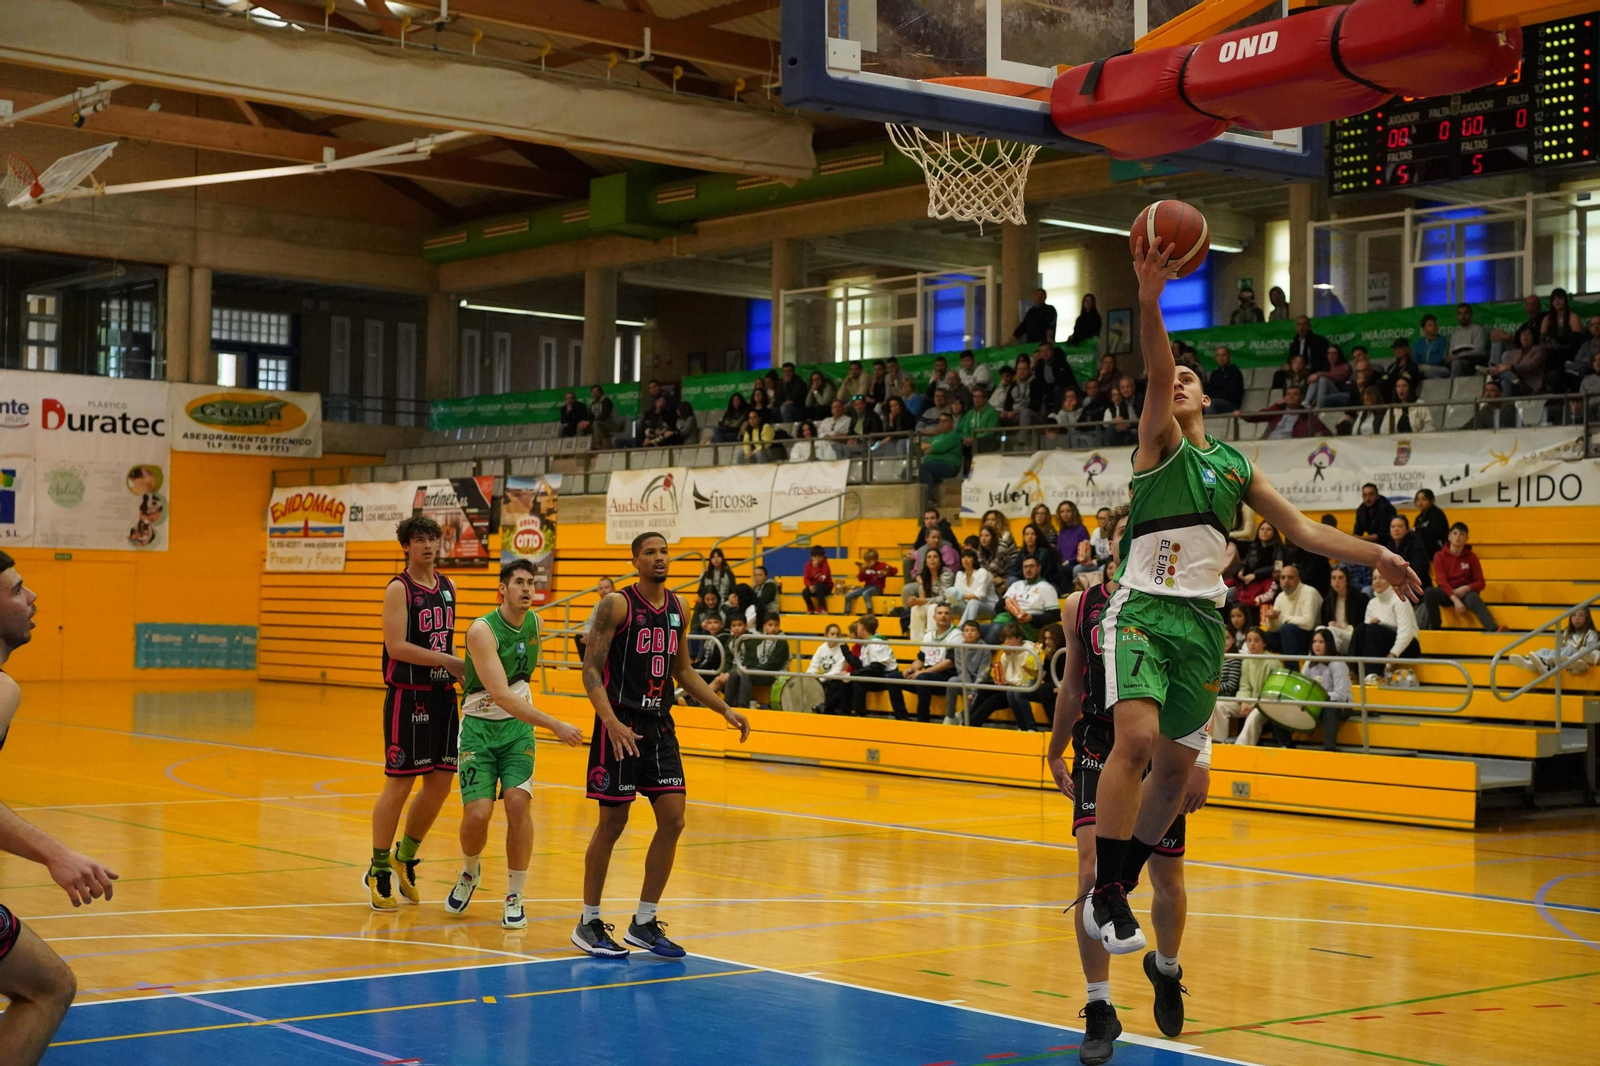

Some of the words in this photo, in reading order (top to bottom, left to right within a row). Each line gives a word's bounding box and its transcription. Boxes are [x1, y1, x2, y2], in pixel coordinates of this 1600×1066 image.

[1218, 30, 1278, 63] OND
[1461, 100, 1494, 114] JUGADOR
[1507, 93, 1530, 106] FALTA
[1388, 111, 1420, 126] JUGADOR
[1429, 107, 1450, 118] FALTA
[1516, 108, 1527, 129] 0
[1387, 127, 1409, 148] 00
[1439, 121, 1450, 140] 0
[1461, 139, 1488, 152] FALTAS
[1387, 150, 1413, 163] FALTAS
[1472, 154, 1483, 174] 5
[1398, 165, 1408, 184] 5
[1361, 327, 1415, 341] INAGROUP
[42, 398, 165, 437] Duratec
[182, 432, 268, 444] ASESORAMIENTO
[270, 436, 312, 447] TECNICO
[231, 443, 250, 451] 950
[1374, 470, 1426, 482] DIPUTACIÓN
[1387, 481, 1424, 492] ALMERÍA
[1497, 474, 1582, 507] EJIDO
[710, 490, 753, 509] fircosa
[270, 492, 346, 525] EJIDOMAR
[520, 519, 538, 528] GRUPO
[516, 534, 540, 549] OTTO
[1160, 539, 1171, 551] EL
[269, 551, 302, 564] Presente
[315, 552, 341, 564] Futuro
[1154, 554, 1168, 585] EJIDO
[636, 627, 678, 655] CBA
[515, 655, 529, 672] 32
[651, 655, 665, 678] 0
[1130, 649, 1145, 677] 7
[411, 712, 429, 722] hita
[460, 766, 479, 789] 32
